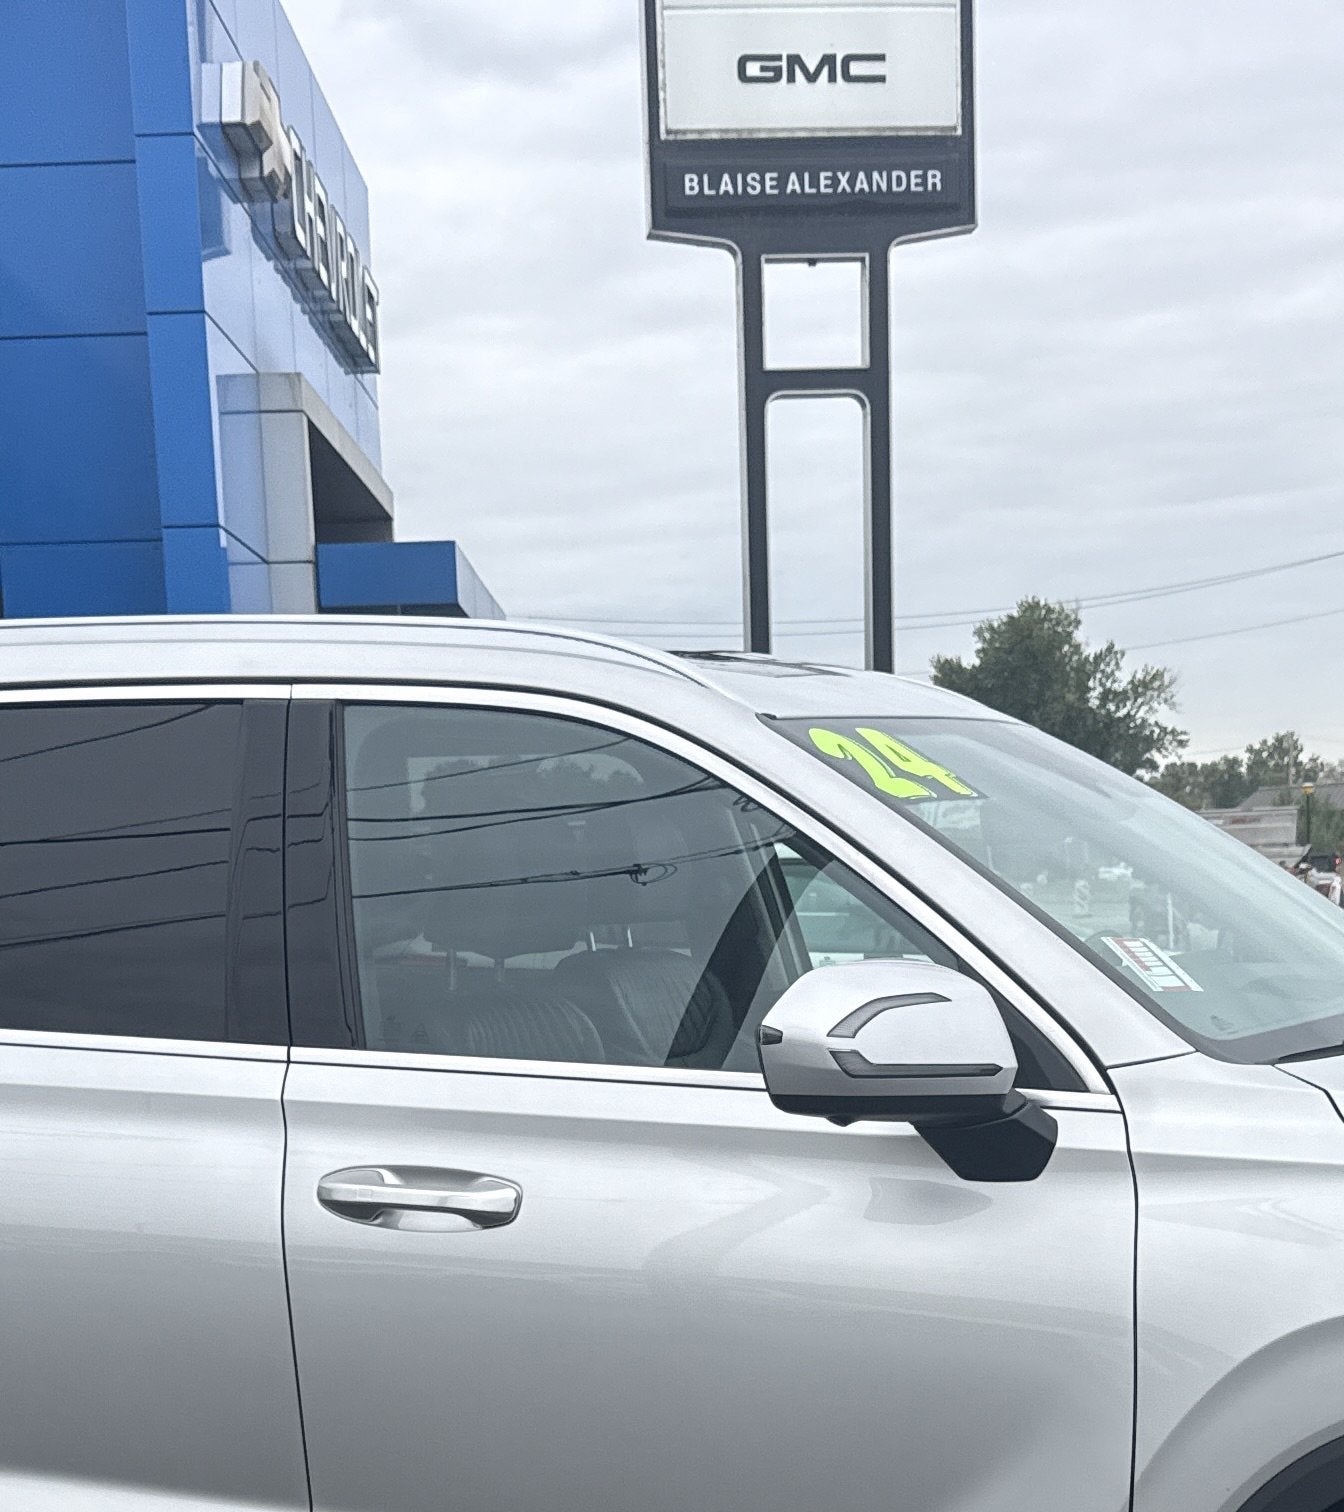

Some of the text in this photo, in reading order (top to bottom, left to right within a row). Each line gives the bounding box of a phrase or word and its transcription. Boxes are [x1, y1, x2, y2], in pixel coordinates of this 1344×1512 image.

[737, 53, 886, 84] GMC
[684, 169, 943, 196] BLAISE ALEXANDER
[808, 727, 979, 800] 24
